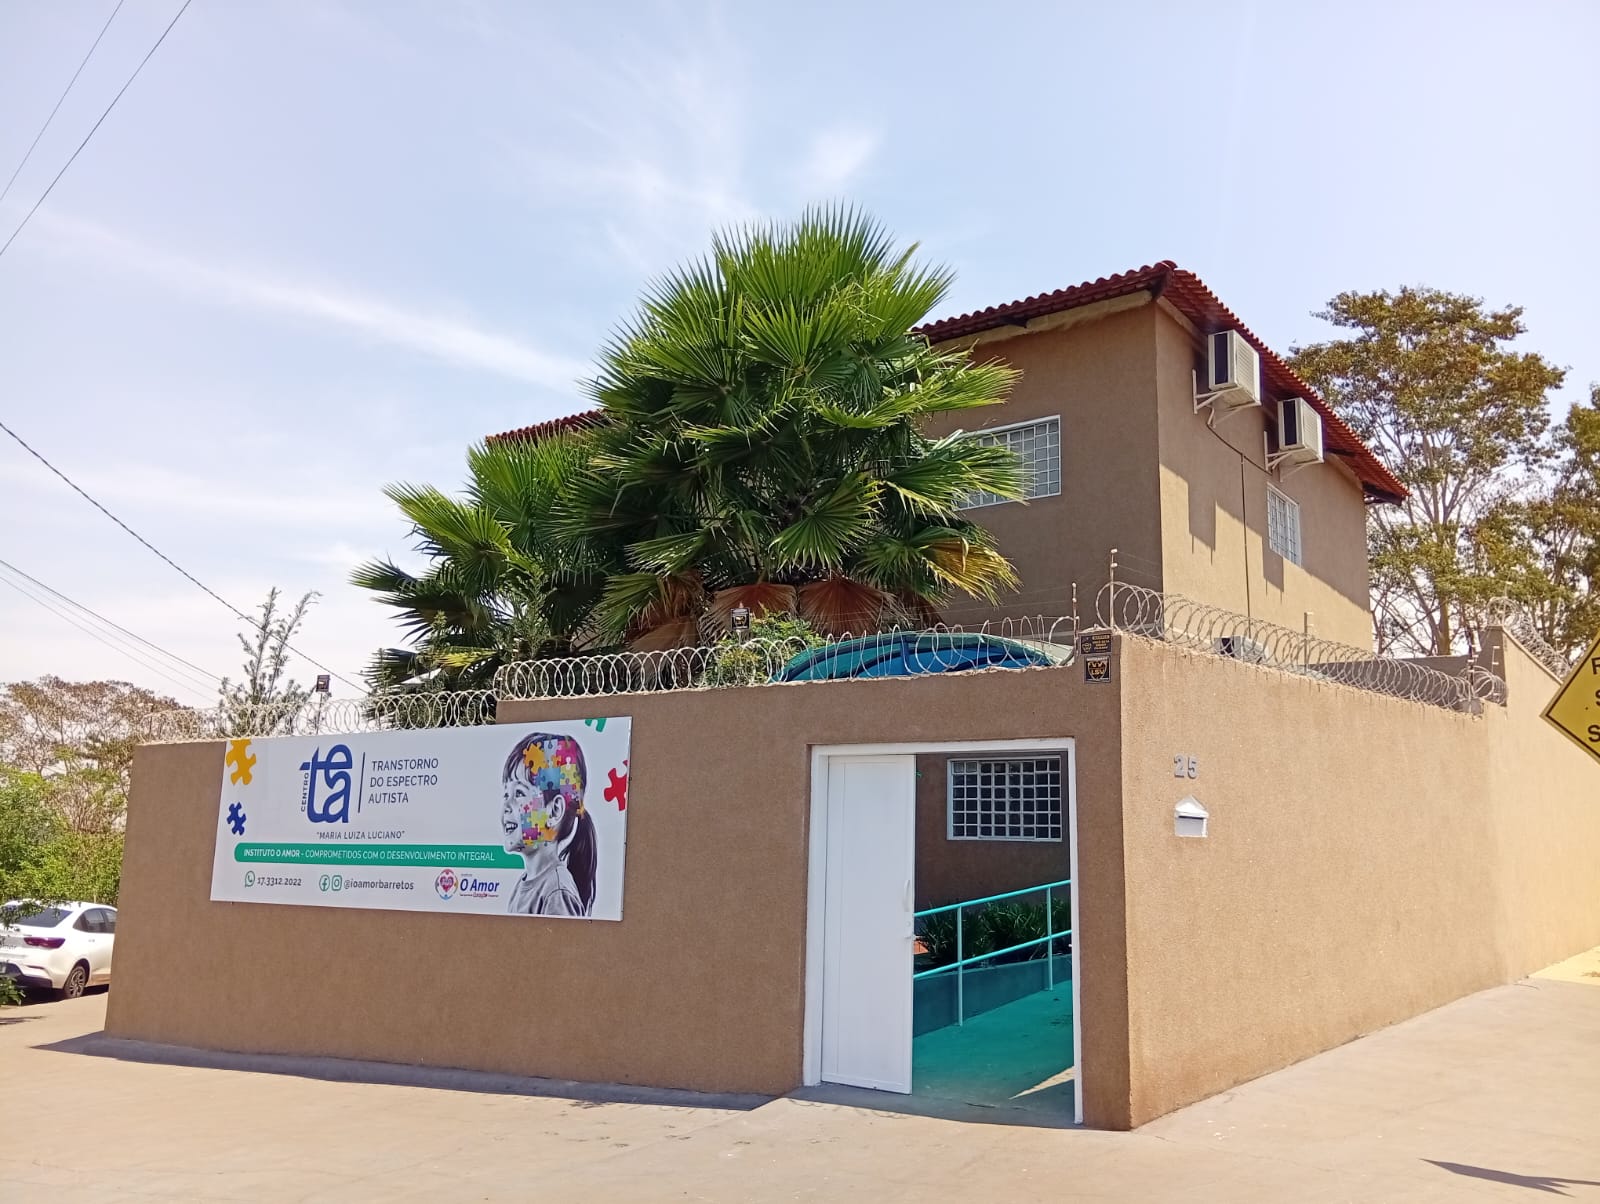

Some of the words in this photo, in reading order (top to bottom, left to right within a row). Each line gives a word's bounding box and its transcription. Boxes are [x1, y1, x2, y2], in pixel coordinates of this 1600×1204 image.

[371, 758, 439, 771] TRANSTORNO
[1173, 754, 1198, 780] 25
[370, 777, 384, 788] DO
[386, 775, 438, 787] ESPECTRO
[300, 772, 309, 812] CENTRO
[368, 792, 409, 804] AUTISTA
[344, 831, 366, 840] LUIZA
[243, 848, 275, 857] INSTITUTO
[275, 849, 281, 858] O
[281, 849, 300, 858] AMOR
[305, 850, 361, 859] COMPROMETIDOS
[362, 851, 379, 860] COM
[380, 851, 386, 860] O
[386, 851, 456, 861] DESENVOLVIMENTO
[457, 852, 495, 861] INTEGRAL
[344, 879, 415, 891] @ioamorbarretos
[460, 878, 469, 892] O
[470, 878, 500, 893] Amor
